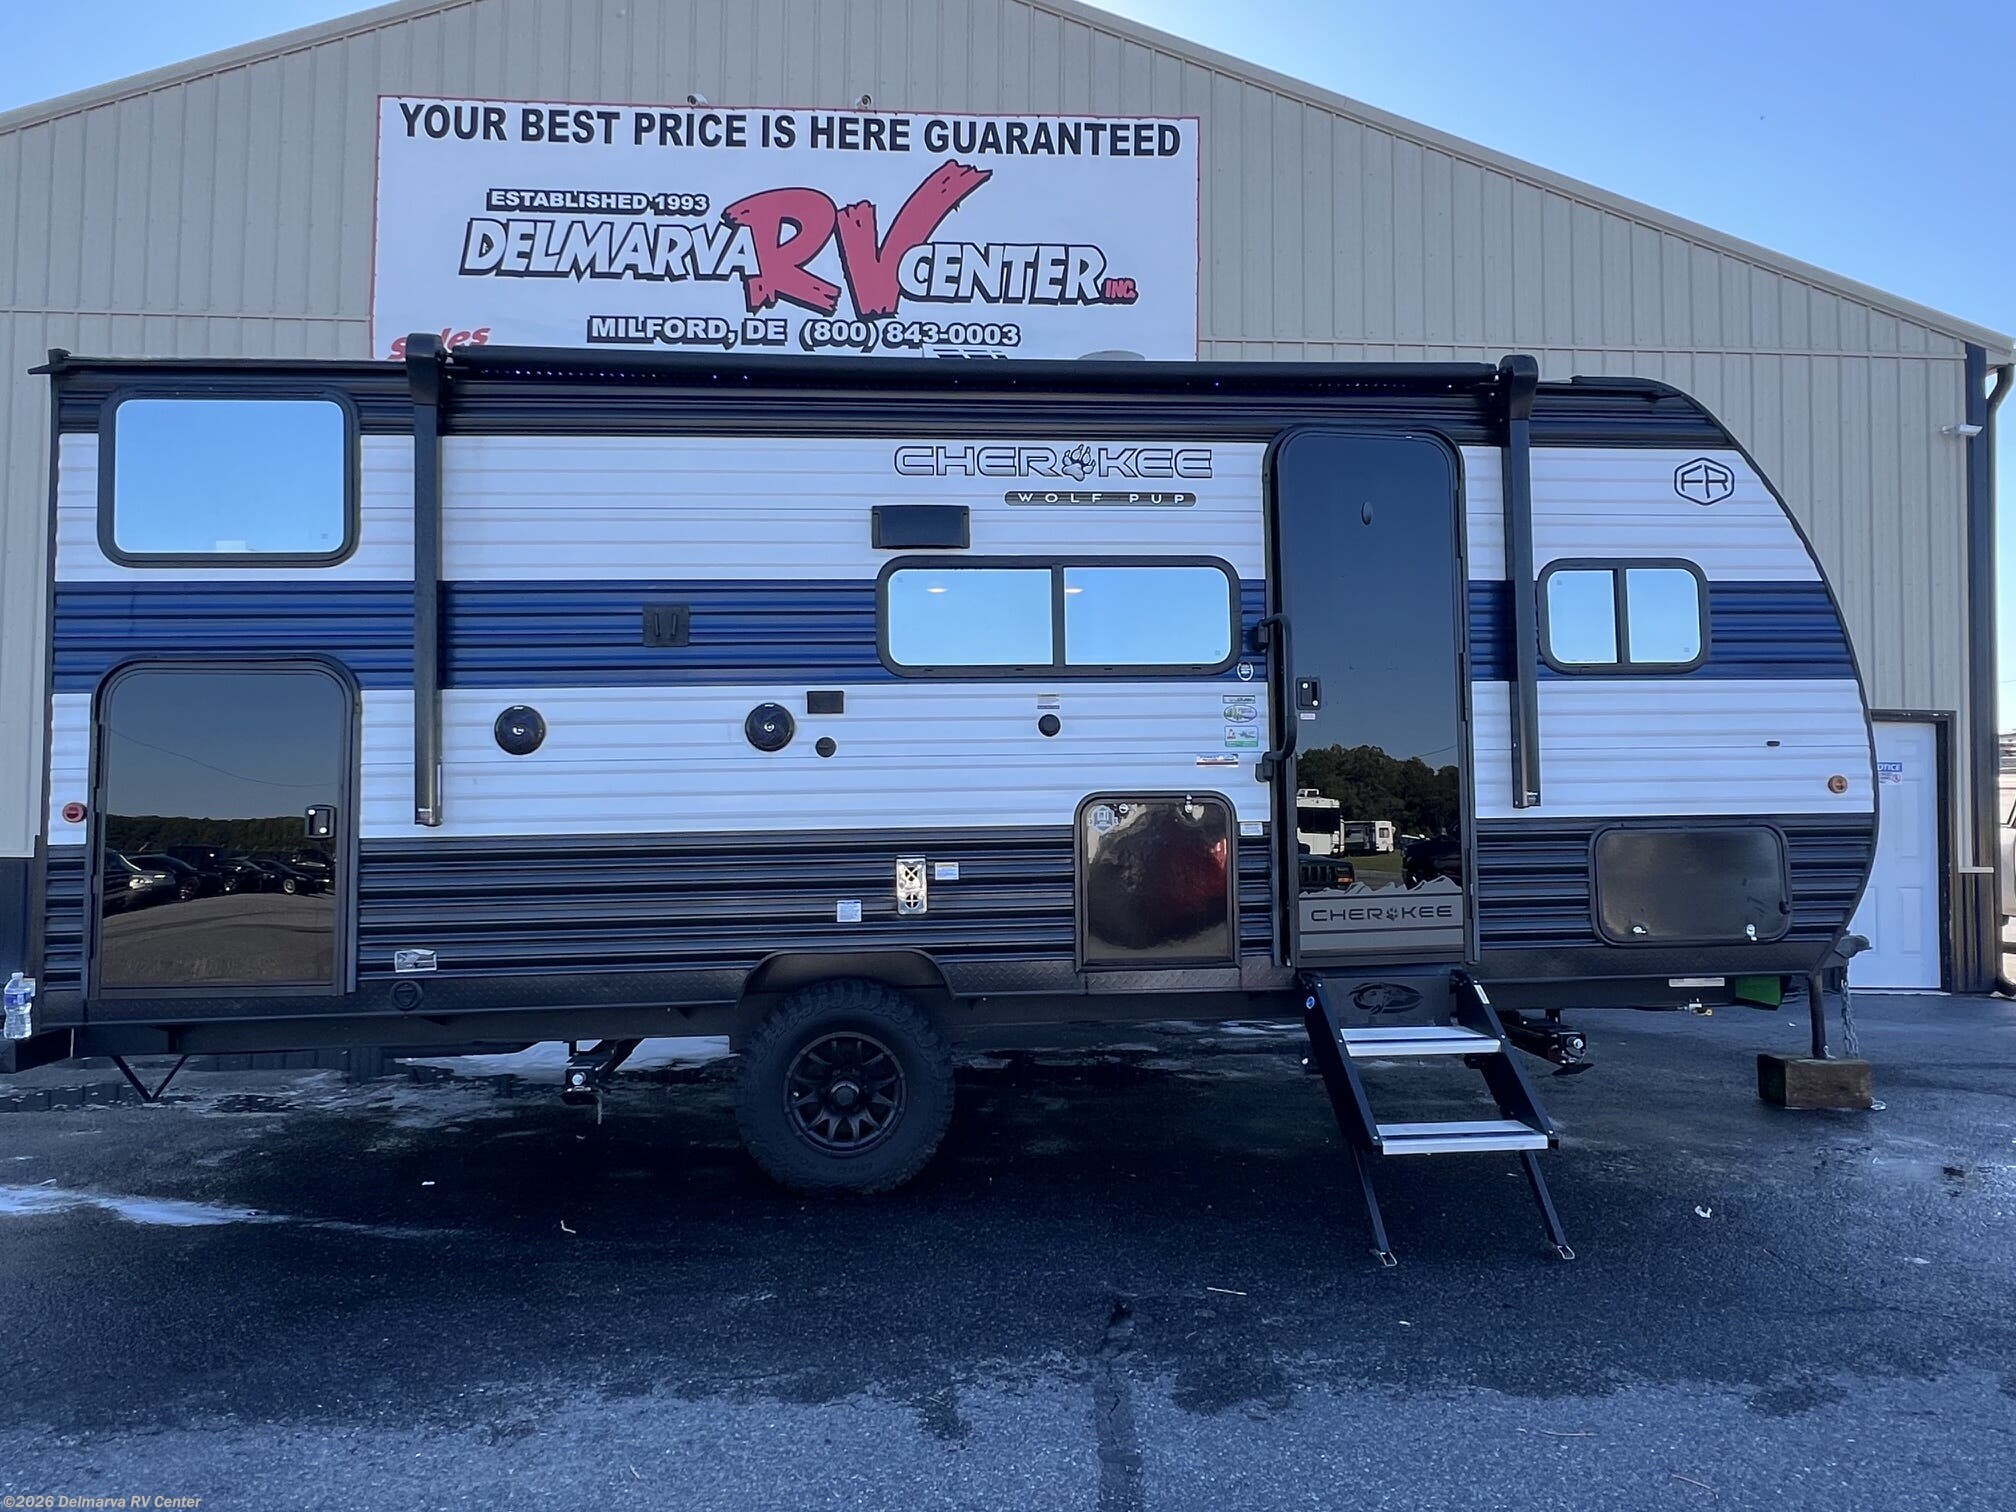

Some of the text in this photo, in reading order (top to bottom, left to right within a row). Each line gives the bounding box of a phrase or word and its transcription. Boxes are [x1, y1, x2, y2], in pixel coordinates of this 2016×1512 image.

[400, 103, 1181, 156] YOUR BEST PRICE IS HERE GUARANTEED
[487, 189, 710, 214] ESTABLISHED 1993
[459, 218, 764, 282] DELMARVA
[722, 159, 993, 320] RV
[896, 241, 1107, 305] CENTER
[587, 315, 1022, 353] MILFORD, DE (800) 843-0003
[1017, 491, 1186, 505] WOLF PUP
[1877, 763, 1901, 771] OTICE
